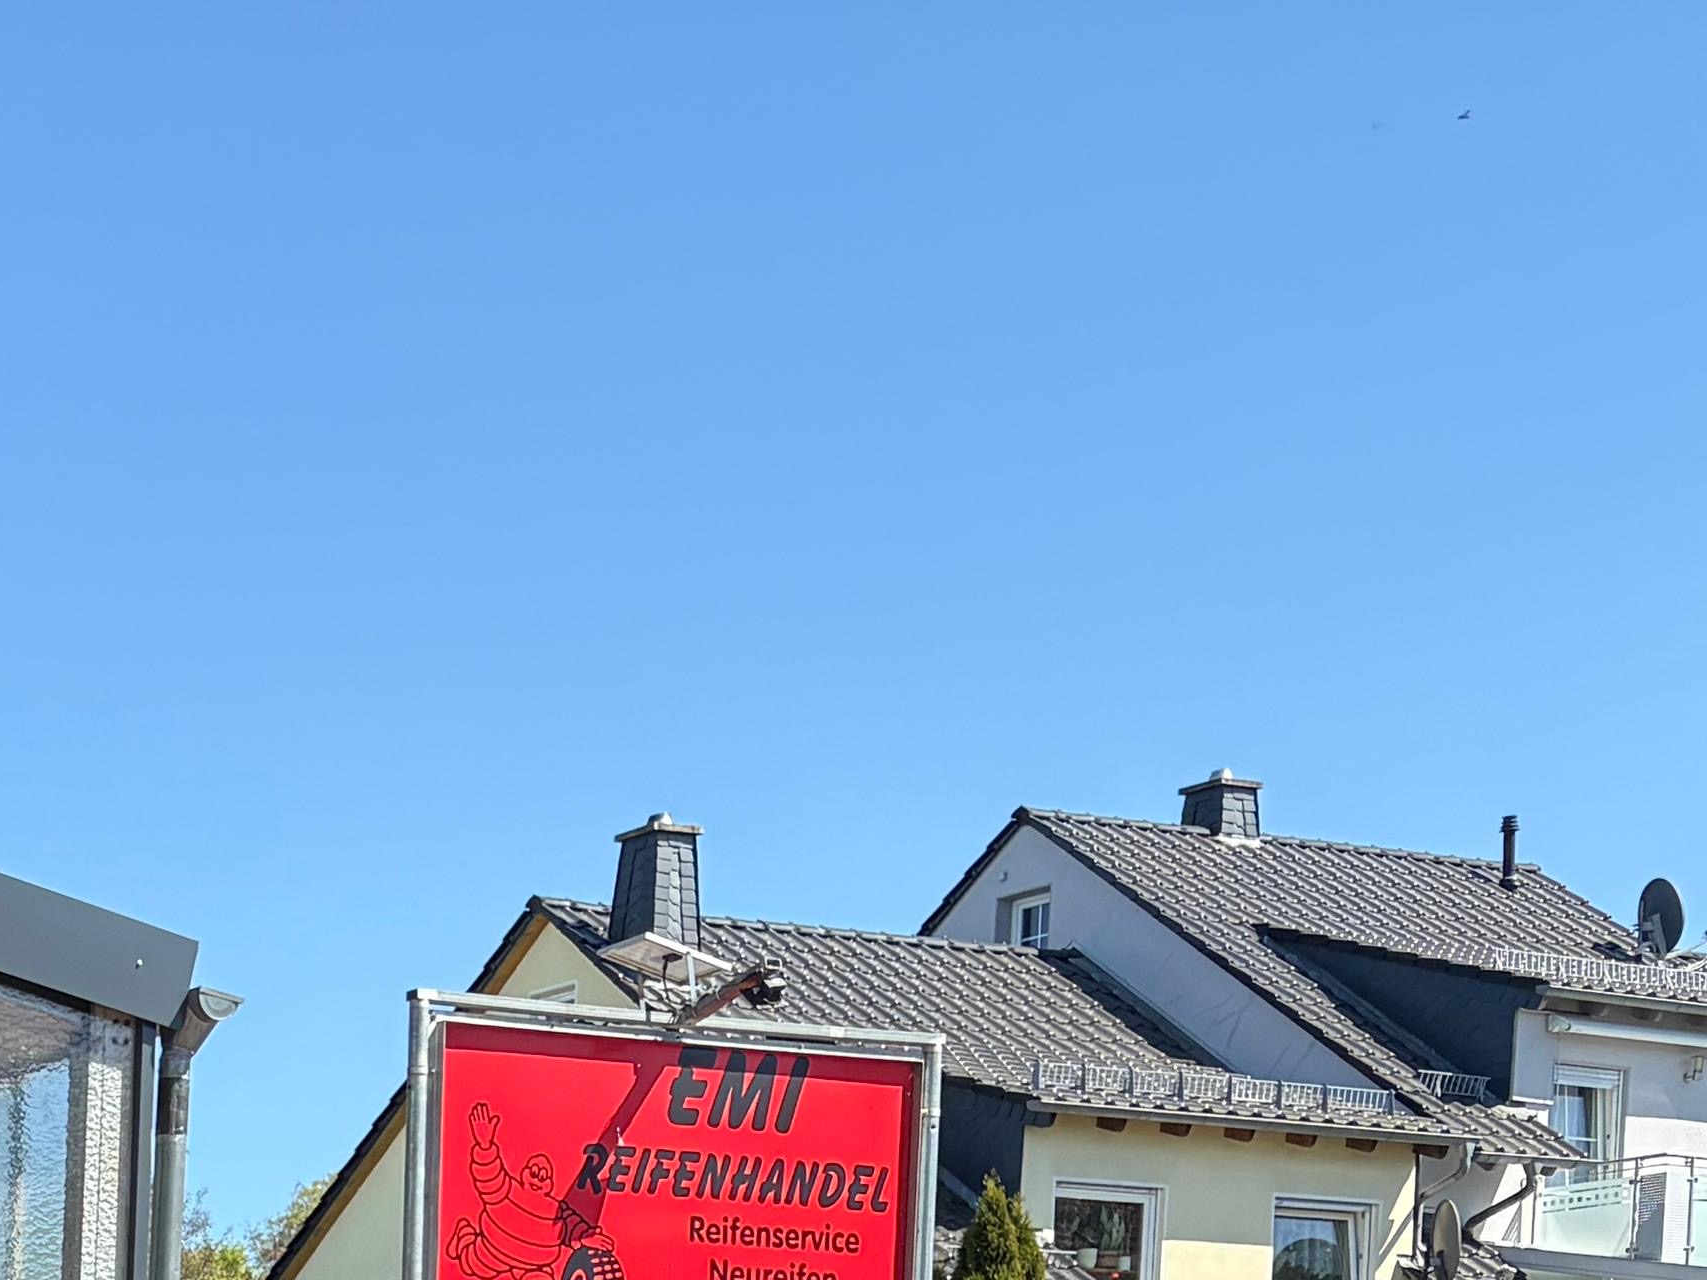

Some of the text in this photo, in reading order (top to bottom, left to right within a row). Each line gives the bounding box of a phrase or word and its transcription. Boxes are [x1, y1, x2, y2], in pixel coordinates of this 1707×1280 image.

[668, 1046, 810, 1134] EMI
[576, 1142, 889, 1213] REIFENHANDEL
[689, 1215, 860, 1254] Reifenservice
